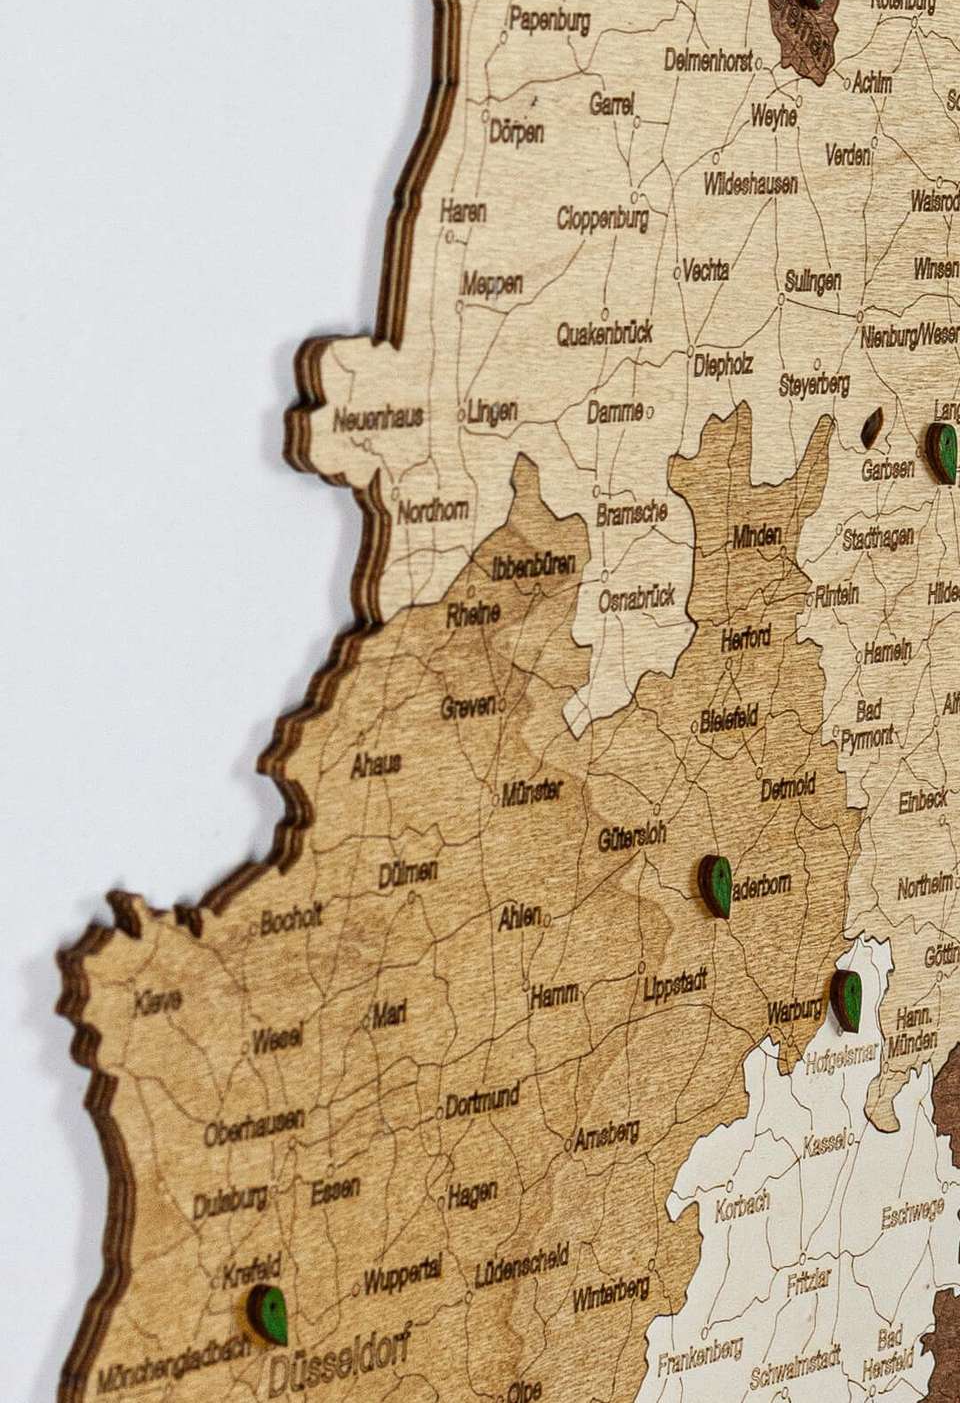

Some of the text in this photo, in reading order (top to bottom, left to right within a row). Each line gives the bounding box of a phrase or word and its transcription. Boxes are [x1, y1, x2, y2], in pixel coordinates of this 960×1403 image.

[509, 6, 591, 36] Papenburg
[665, 48, 752, 73] Delmenhorst
[852, 70, 892, 94] Achim
[590, 92, 634, 116] Garrel
[752, 104, 797, 128] Weyhe
[490, 117, 544, 144] Dörpen
[827, 144, 870, 166] Verden
[704, 172, 798, 196] Wildeshausen
[440, 198, 486, 223] Haren
[557, 204, 649, 234] Cloppenburg
[683, 257, 729, 281] Vechta
[915, 256, 959, 279] Winsen
[462, 271, 523, 300] Meppen
[785, 269, 841, 296] Sulingen
[557, 318, 652, 347] Quakenbrück
[861, 321, 960, 351] Nienburg/Weser
[694, 352, 753, 379] Diepholz
[779, 371, 850, 398] Steyerberg
[333, 404, 423, 434] Neuenhaus
[467, 398, 518, 425] Lingen
[587, 398, 644, 425] Damme
[861, 457, 915, 481] Garbsen
[398, 498, 469, 524] Nordhorn
[597, 501, 668, 527] Bramsche
[733, 525, 781, 549] Minden
[843, 526, 914, 553] Stadthagen
[493, 551, 575, 582] Ibbenbüren
[600, 583, 675, 614] Osnabrück
[815, 584, 859, 609] Rinteln
[447, 601, 500, 628] Rheine
[722, 624, 771, 653] Herford
[864, 640, 912, 666] Hameln
[440, 695, 496, 721] Greven
[701, 703, 758, 734] Bielefeld
[856, 698, 881, 723] Bad
[841, 723, 894, 755] Pyrmont
[350, 753, 401, 779] Ahaus
[501, 778, 564, 808] Münster
[761, 772, 816, 801] Detmold
[899, 790, 948, 814] Einbeck
[599, 821, 667, 853] Gütersloh
[379, 858, 438, 889] Dülmen
[898, 872, 953, 900] Northeim
[499, 904, 541, 933] Ahlen
[528, 981, 579, 1010] Hamm
[644, 967, 707, 1002] Lippstadt
[372, 998, 407, 1029] Marl
[768, 997, 823, 1024] Warburg
[897, 1007, 931, 1031] Hann.
[252, 1021, 303, 1054] Wesel
[888, 1031, 938, 1059] Münden
[806, 1040, 878, 1076] Hofgeismar
[445, 1079, 520, 1119] Dortmund
[574, 1119, 640, 1153] Arnsberg
[802, 1128, 845, 1159] Kassel
[447, 1180, 497, 1211] Hagen
[715, 1190, 770, 1224] Korbach
[881, 1196, 945, 1231] Eschwege
[364, 1252, 442, 1295] Wuppertal
[474, 1242, 570, 1290] Lüdenscheid
[573, 1274, 651, 1313] Winterberg
[787, 1266, 831, 1298] Fritzlar
[878, 1324, 903, 1351] Bad
[267, 1322, 412, 1399] Düsseldorf
[657, 1336, 743, 1377] Frankenberg
[750, 1344, 842, 1391] Schwalmstadt
[863, 1348, 914, 1381] Hersfeld
